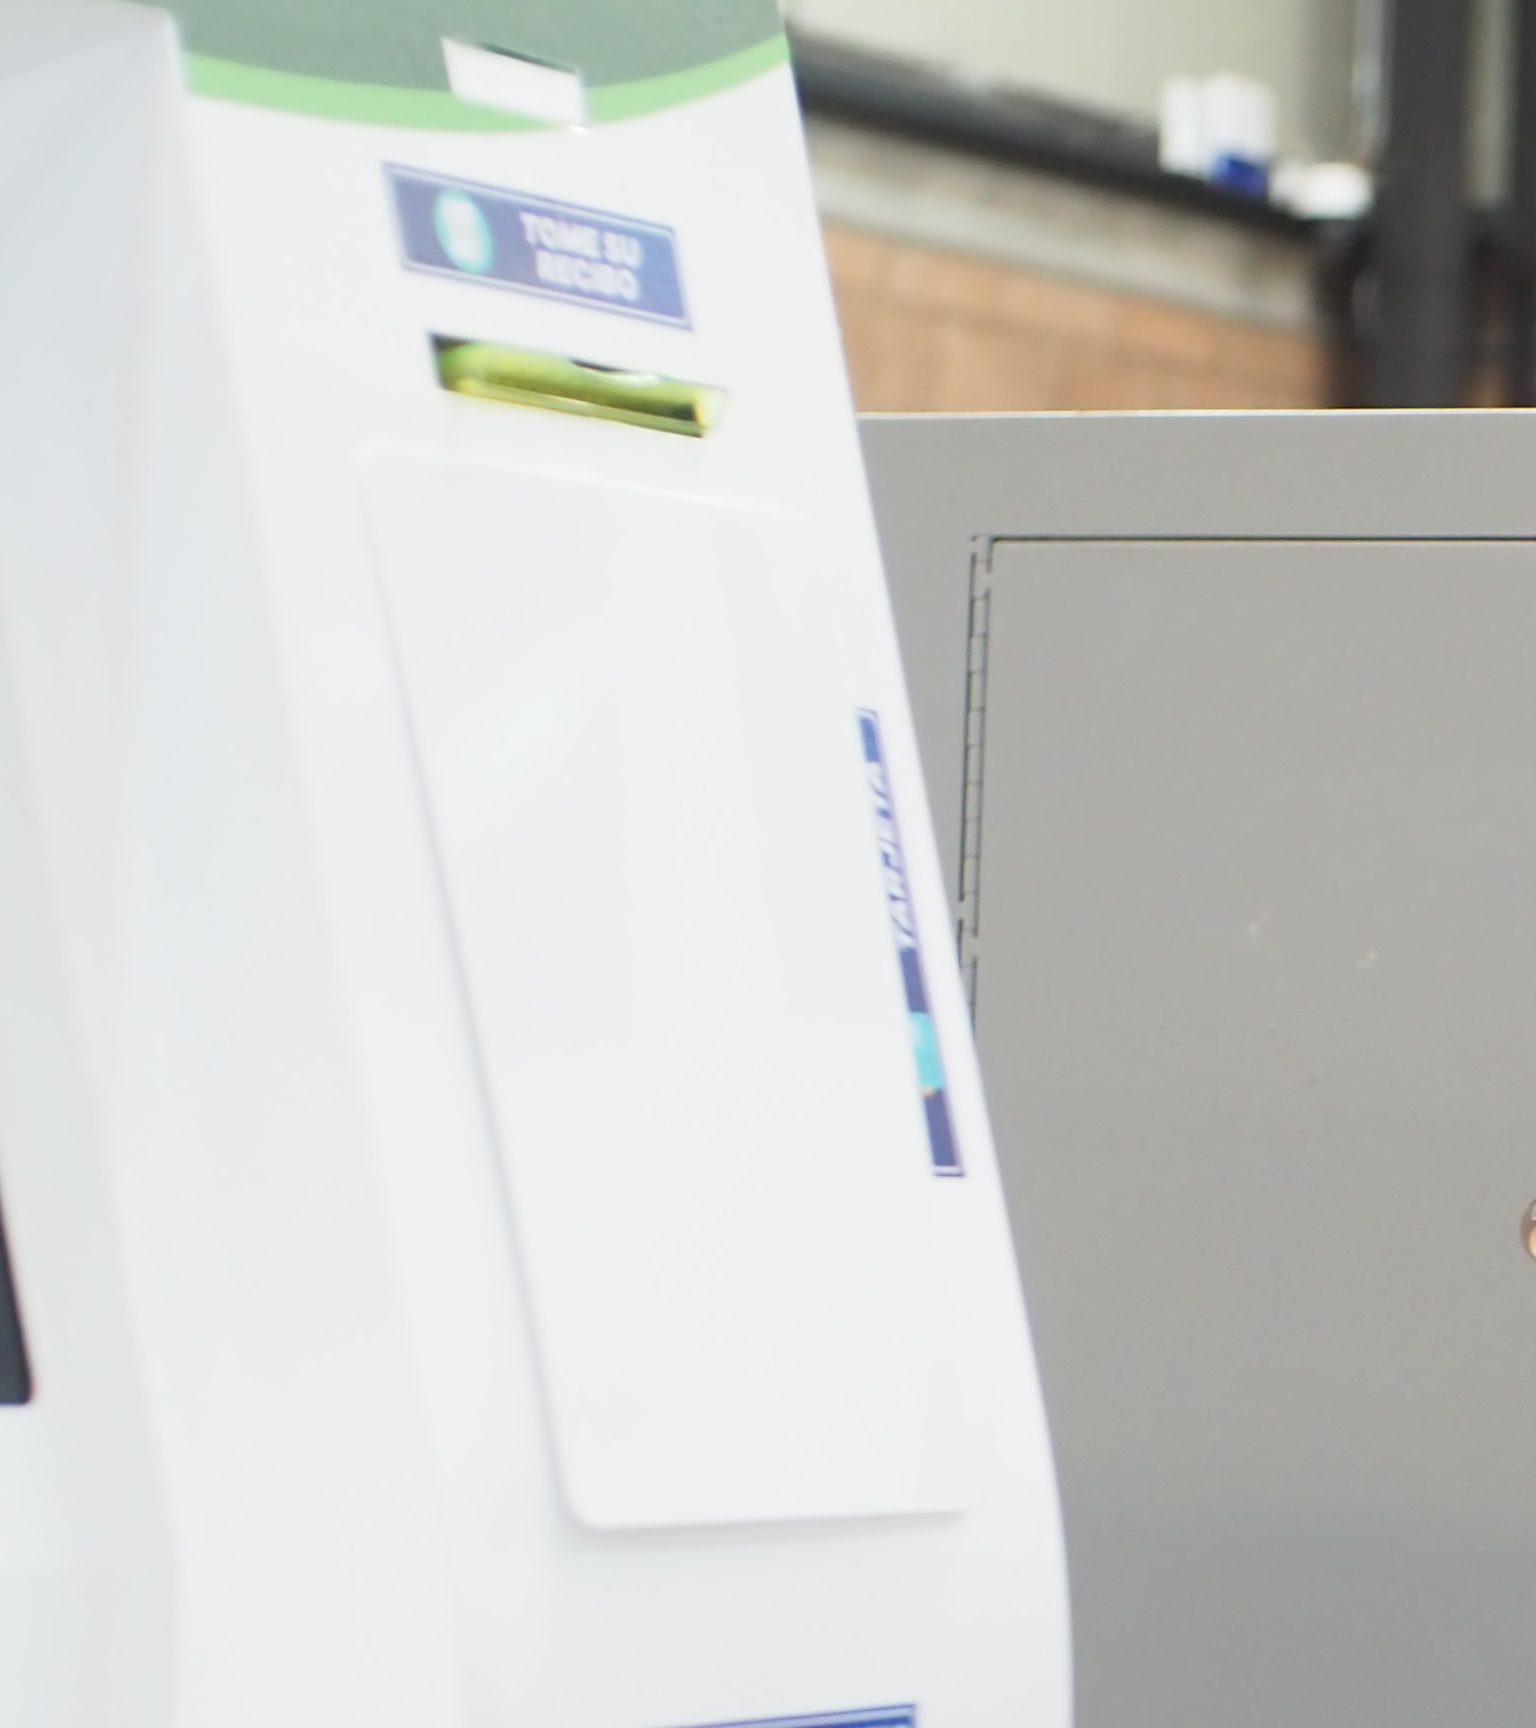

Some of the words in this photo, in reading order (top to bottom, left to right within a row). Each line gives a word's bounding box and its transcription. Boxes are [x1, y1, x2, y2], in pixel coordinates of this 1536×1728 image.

[519, 209, 601, 259] TOME
[602, 231, 642, 269] SU
[535, 249, 640, 301] RECIBO
